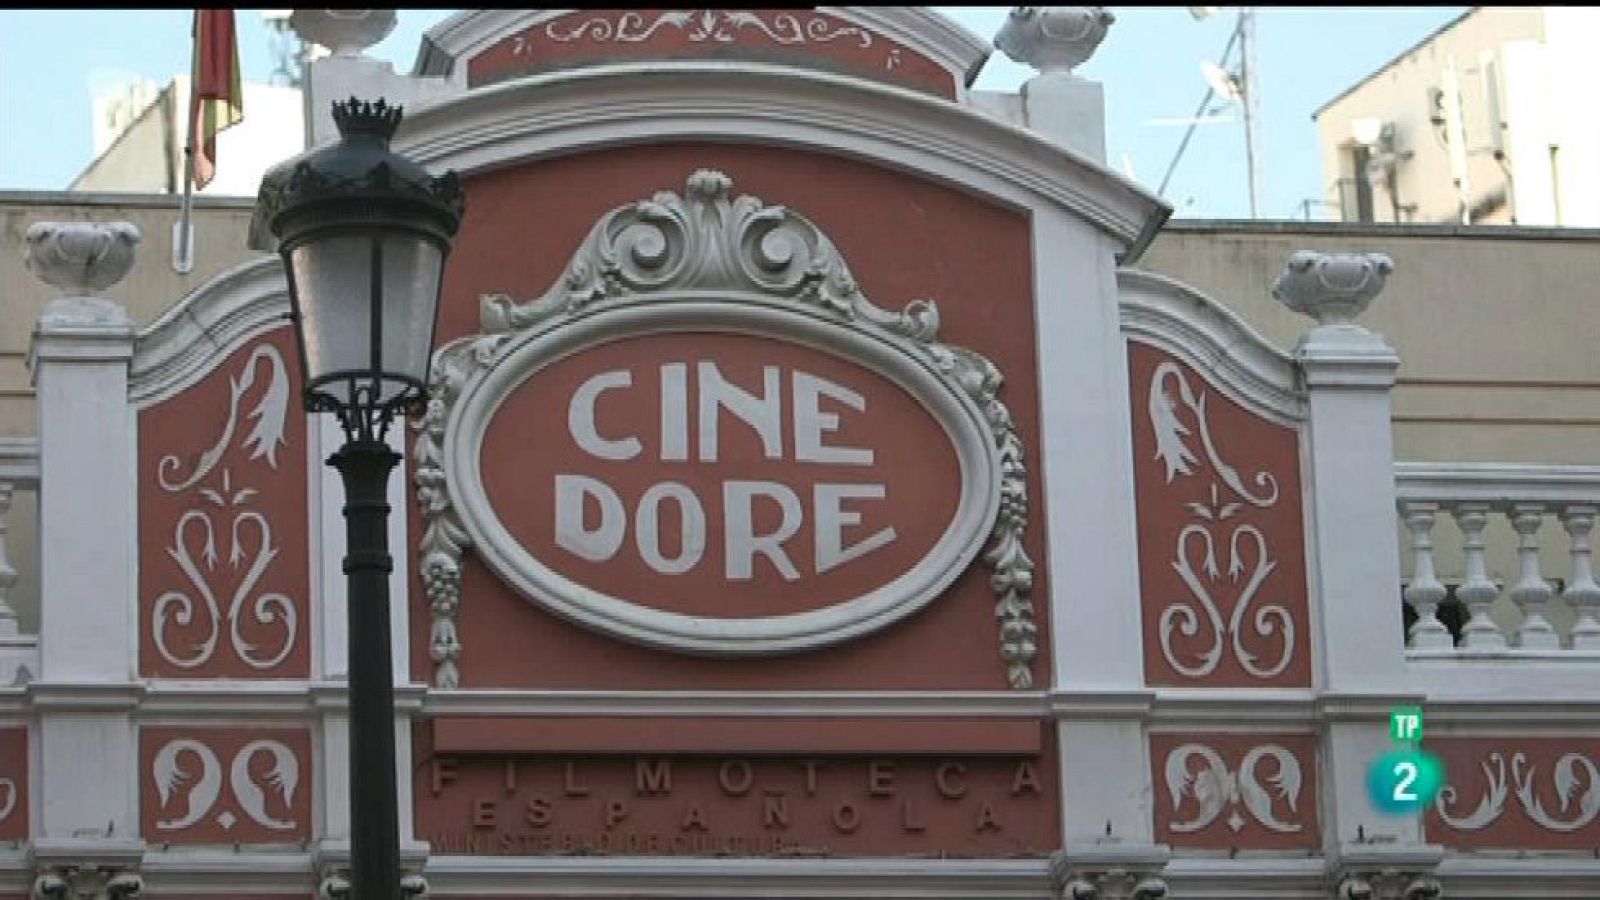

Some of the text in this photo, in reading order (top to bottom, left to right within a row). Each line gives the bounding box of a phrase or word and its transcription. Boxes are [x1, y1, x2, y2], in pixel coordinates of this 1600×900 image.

[567, 361, 875, 466] CINE
[554, 474, 898, 581] DORE
[431, 759, 1042, 798] FILMOTECA
[472, 790, 1002, 833] ESPAÑOLA
